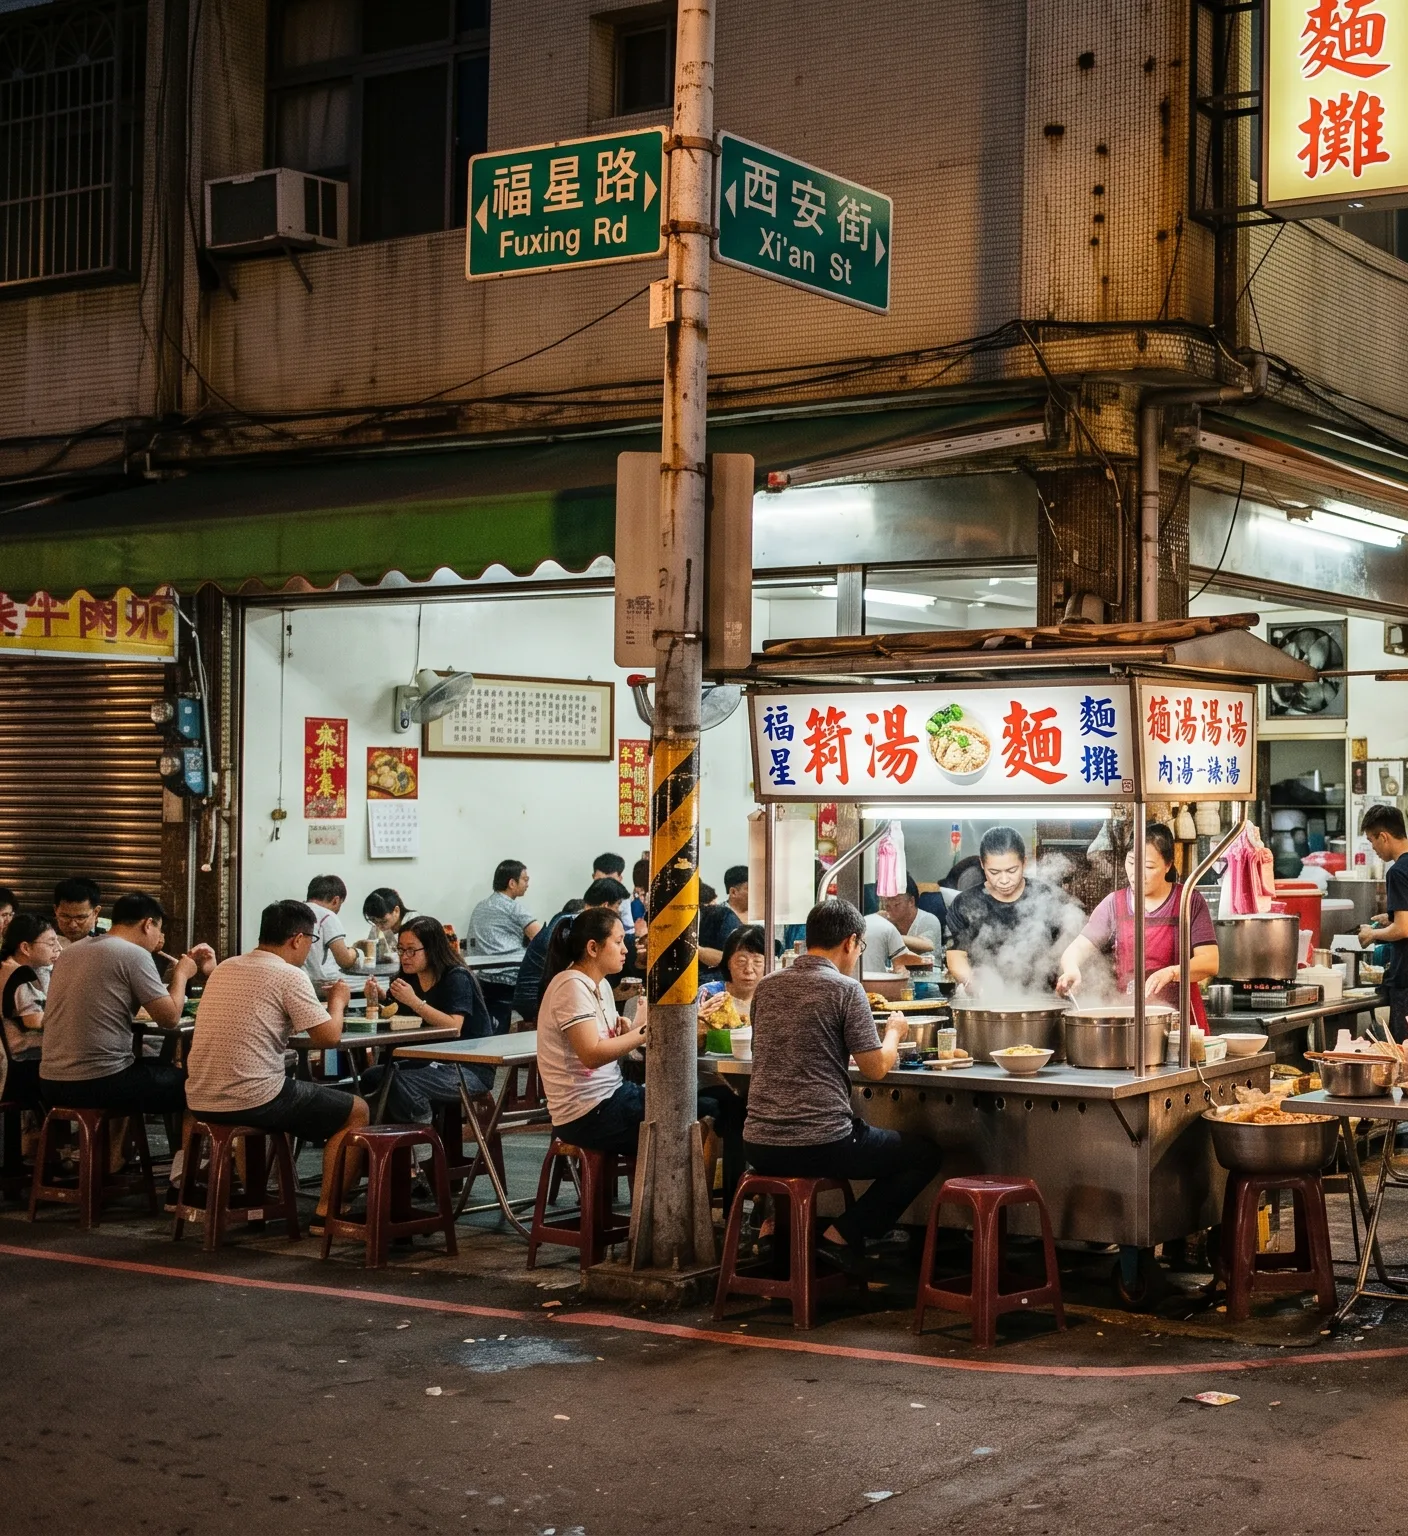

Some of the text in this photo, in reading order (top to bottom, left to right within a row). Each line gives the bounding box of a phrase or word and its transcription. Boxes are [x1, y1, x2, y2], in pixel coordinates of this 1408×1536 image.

[1297, 0, 1391, 179] 麵攤
[492, 147, 638, 220] 福星路
[742, 157, 872, 252] 西安街
[500, 215, 627, 259] Fuxing Rd
[759, 227, 852, 285] Xi'an St
[763, 705, 796, 786] 福星
[1001, 701, 1068, 784] 麵
[1079, 695, 1122, 786] 麵攤
